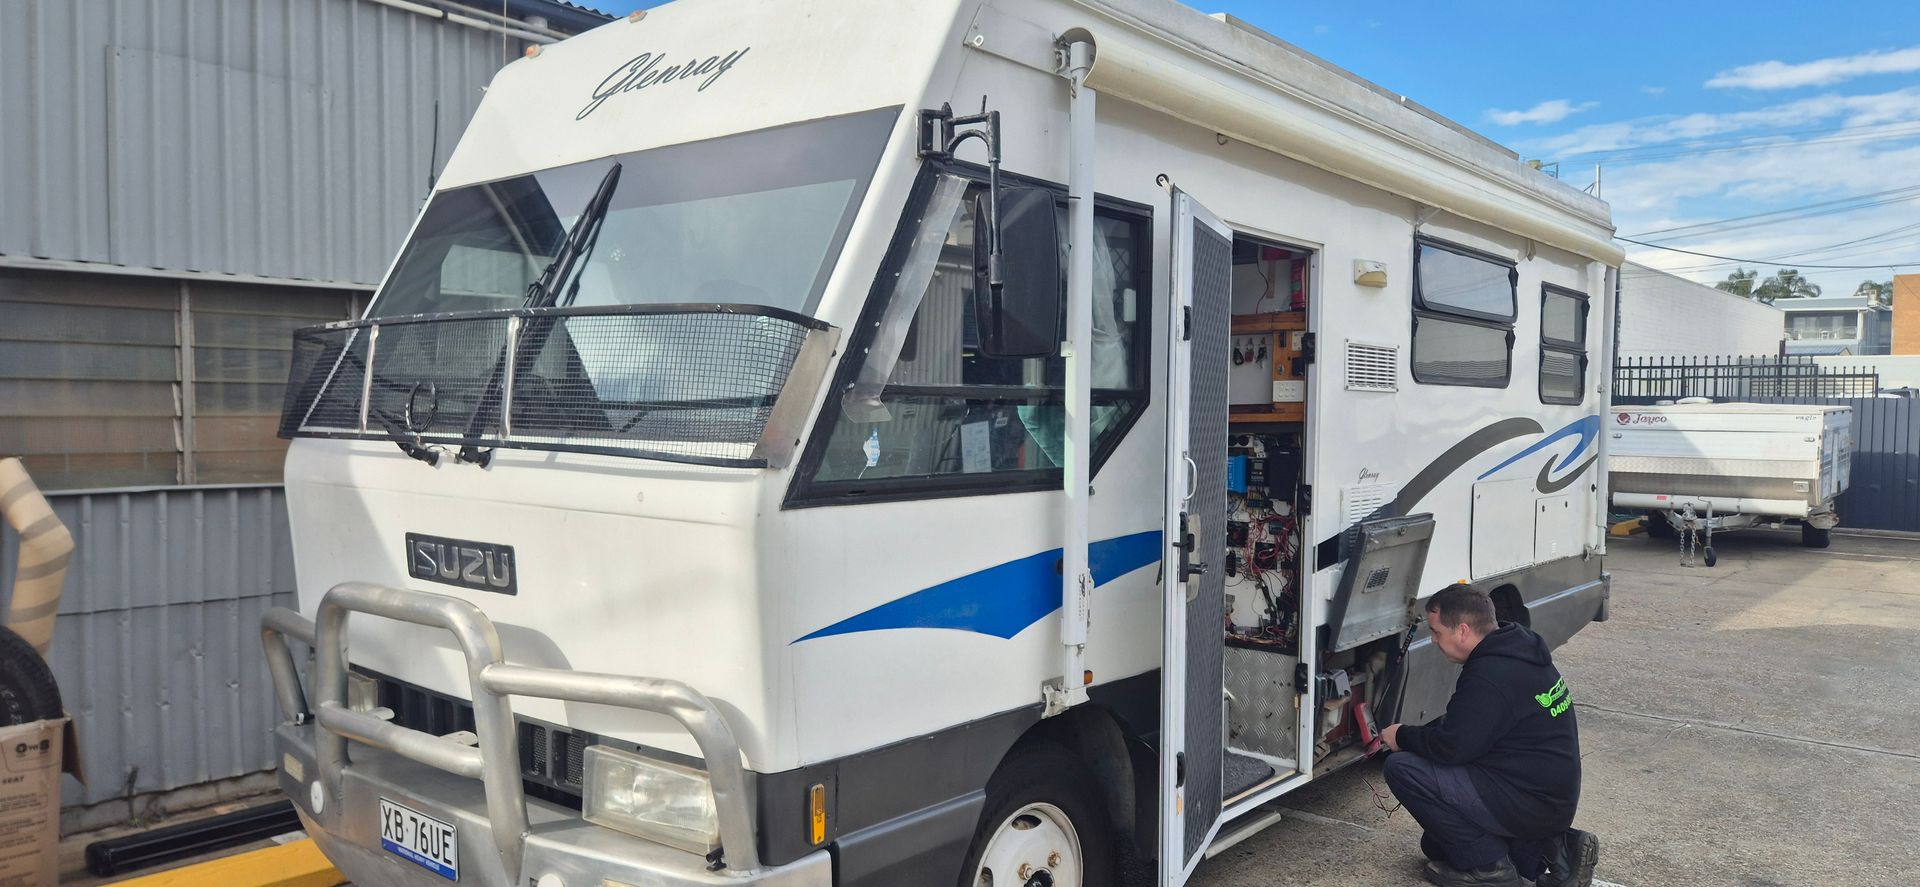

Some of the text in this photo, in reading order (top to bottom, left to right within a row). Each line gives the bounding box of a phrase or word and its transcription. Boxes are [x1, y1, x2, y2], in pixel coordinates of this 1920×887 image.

[576, 47, 750, 121] Glenray
[1632, 413, 1668, 425] Jayco
[409, 540, 510, 587] ISUZU
